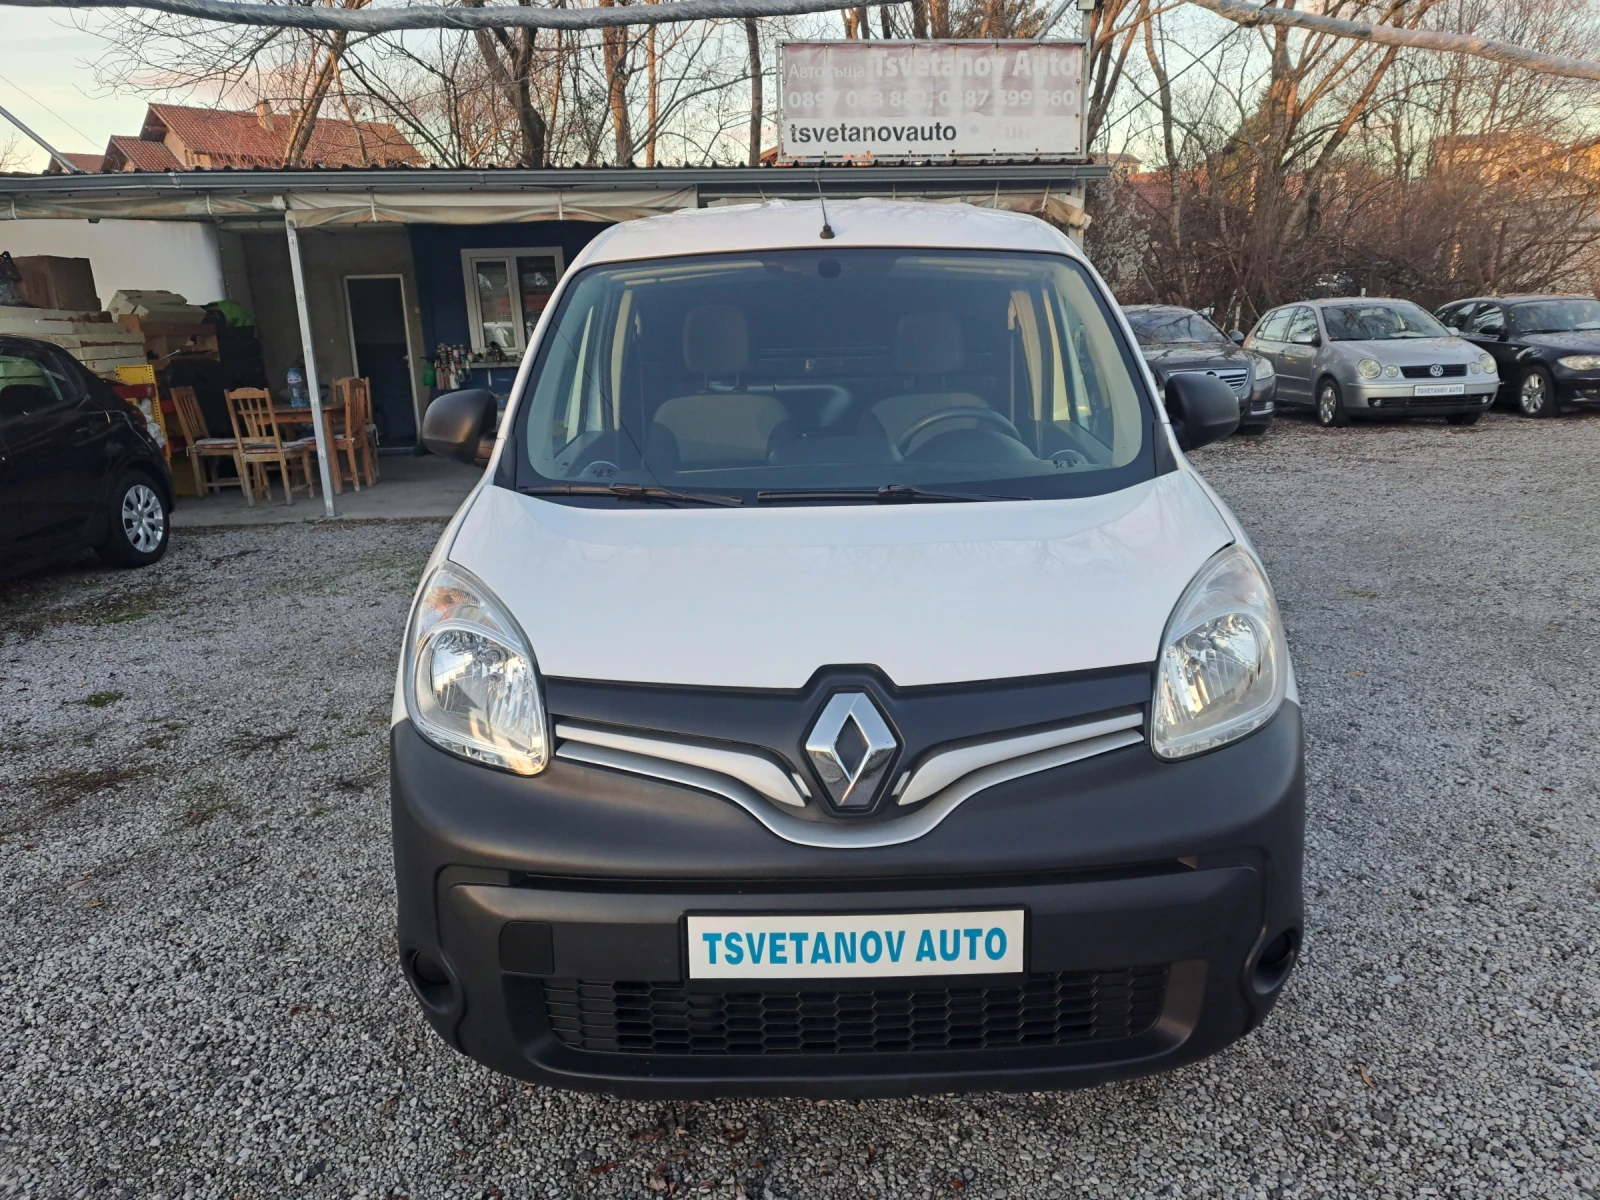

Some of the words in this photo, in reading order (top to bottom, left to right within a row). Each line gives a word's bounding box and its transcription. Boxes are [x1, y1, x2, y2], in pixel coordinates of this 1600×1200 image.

[788, 63, 866, 80] Автоъща
[869, 50, 1007, 77] Tsvetanov
[1012, 49, 1076, 77] Auto
[938, 89, 990, 107] 087
[789, 122, 957, 143] tsvetanovauto
[702, 930, 906, 965] TSVETANOV
[915, 927, 1007, 962] AUTO
